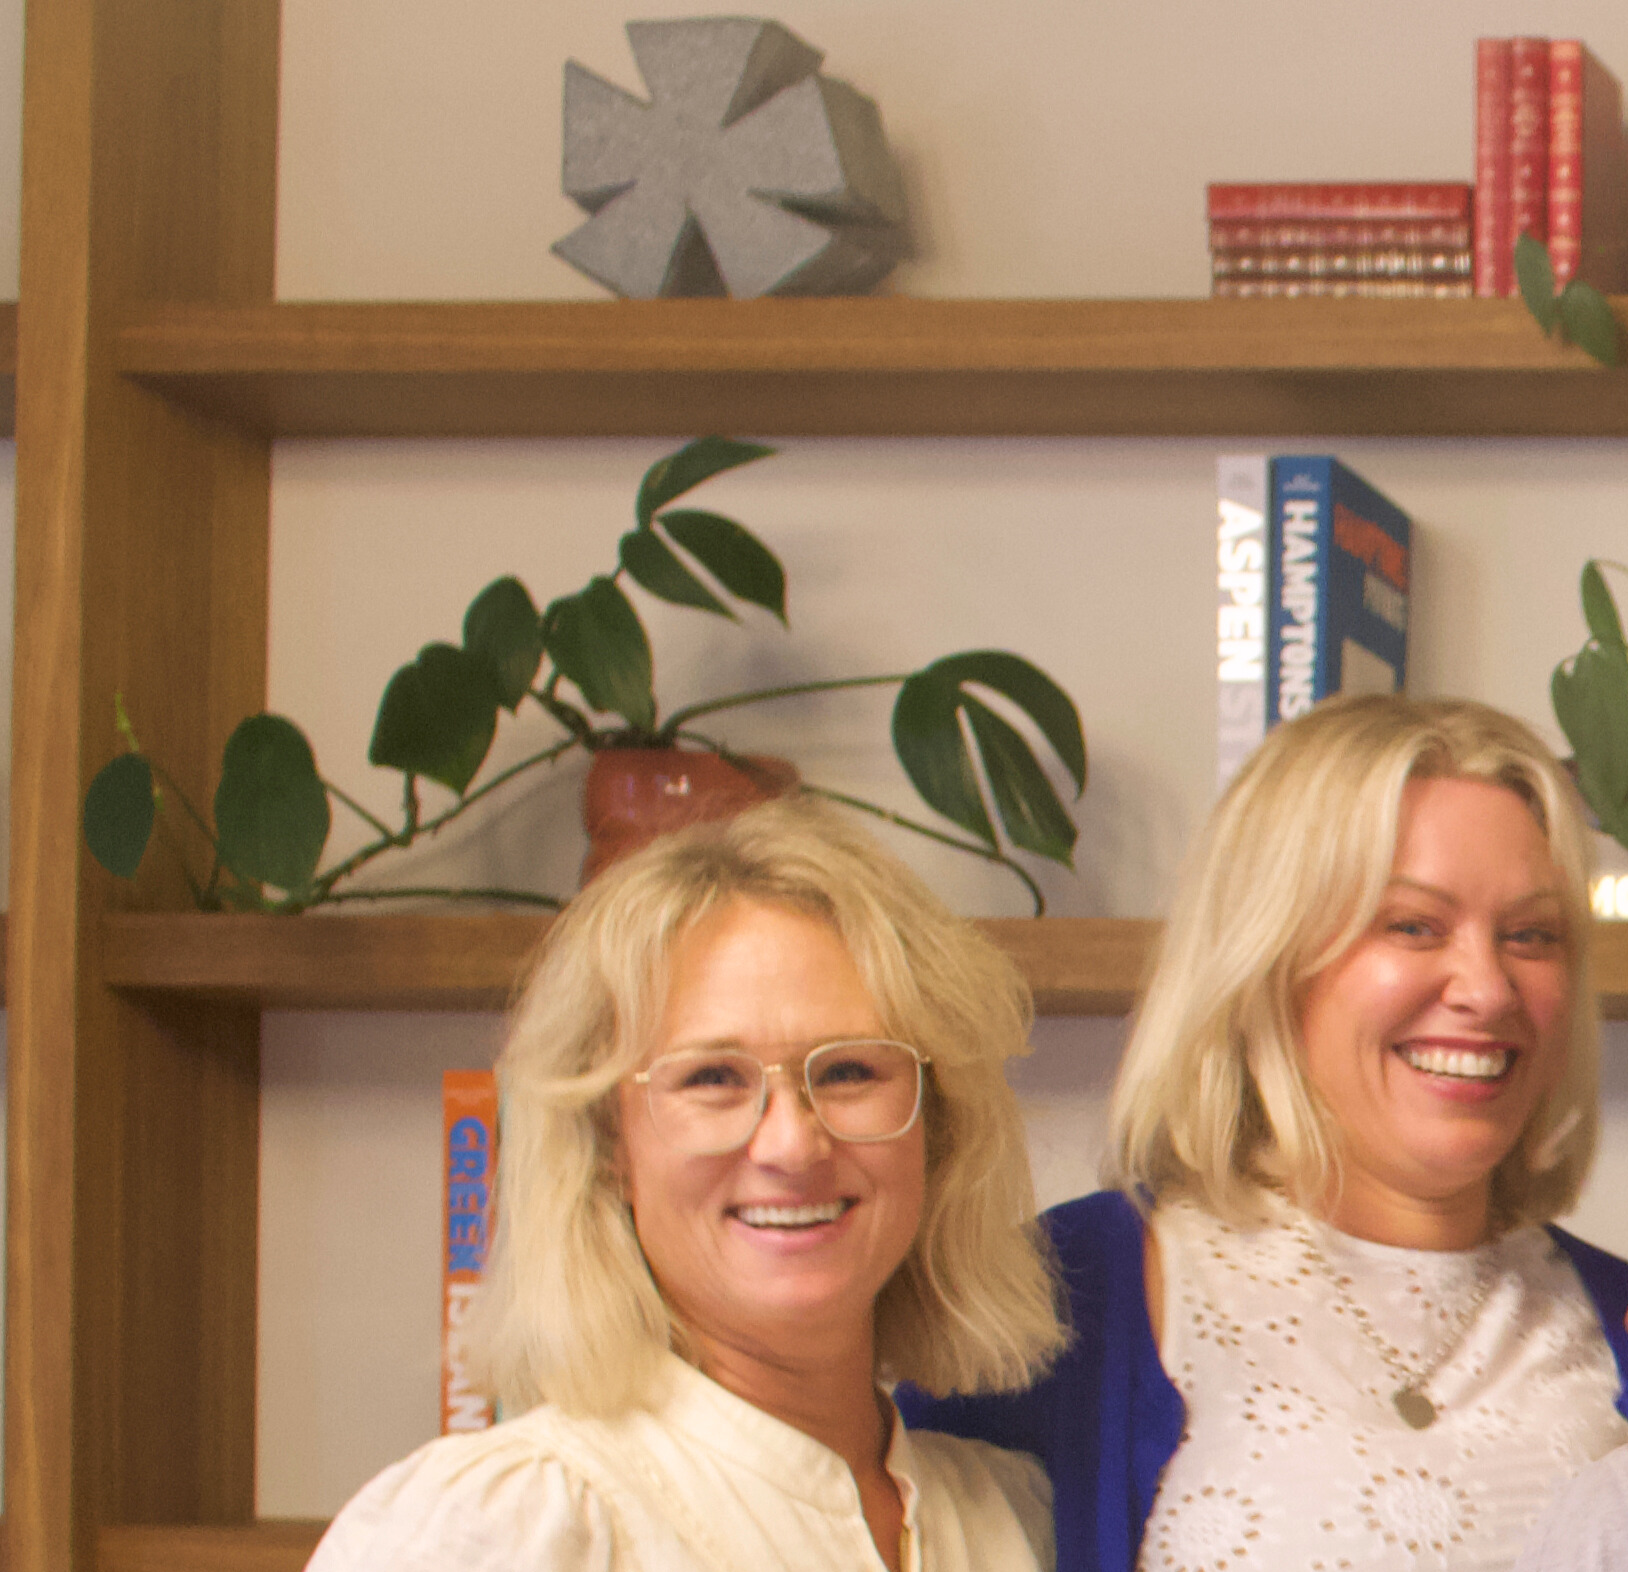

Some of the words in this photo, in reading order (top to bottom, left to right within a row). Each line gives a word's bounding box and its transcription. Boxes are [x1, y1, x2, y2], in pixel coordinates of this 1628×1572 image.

[1217, 498, 1264, 683] ASPEN
[1279, 499, 1320, 722] HAMPTONS
[448, 1116, 488, 1274] GREEK
